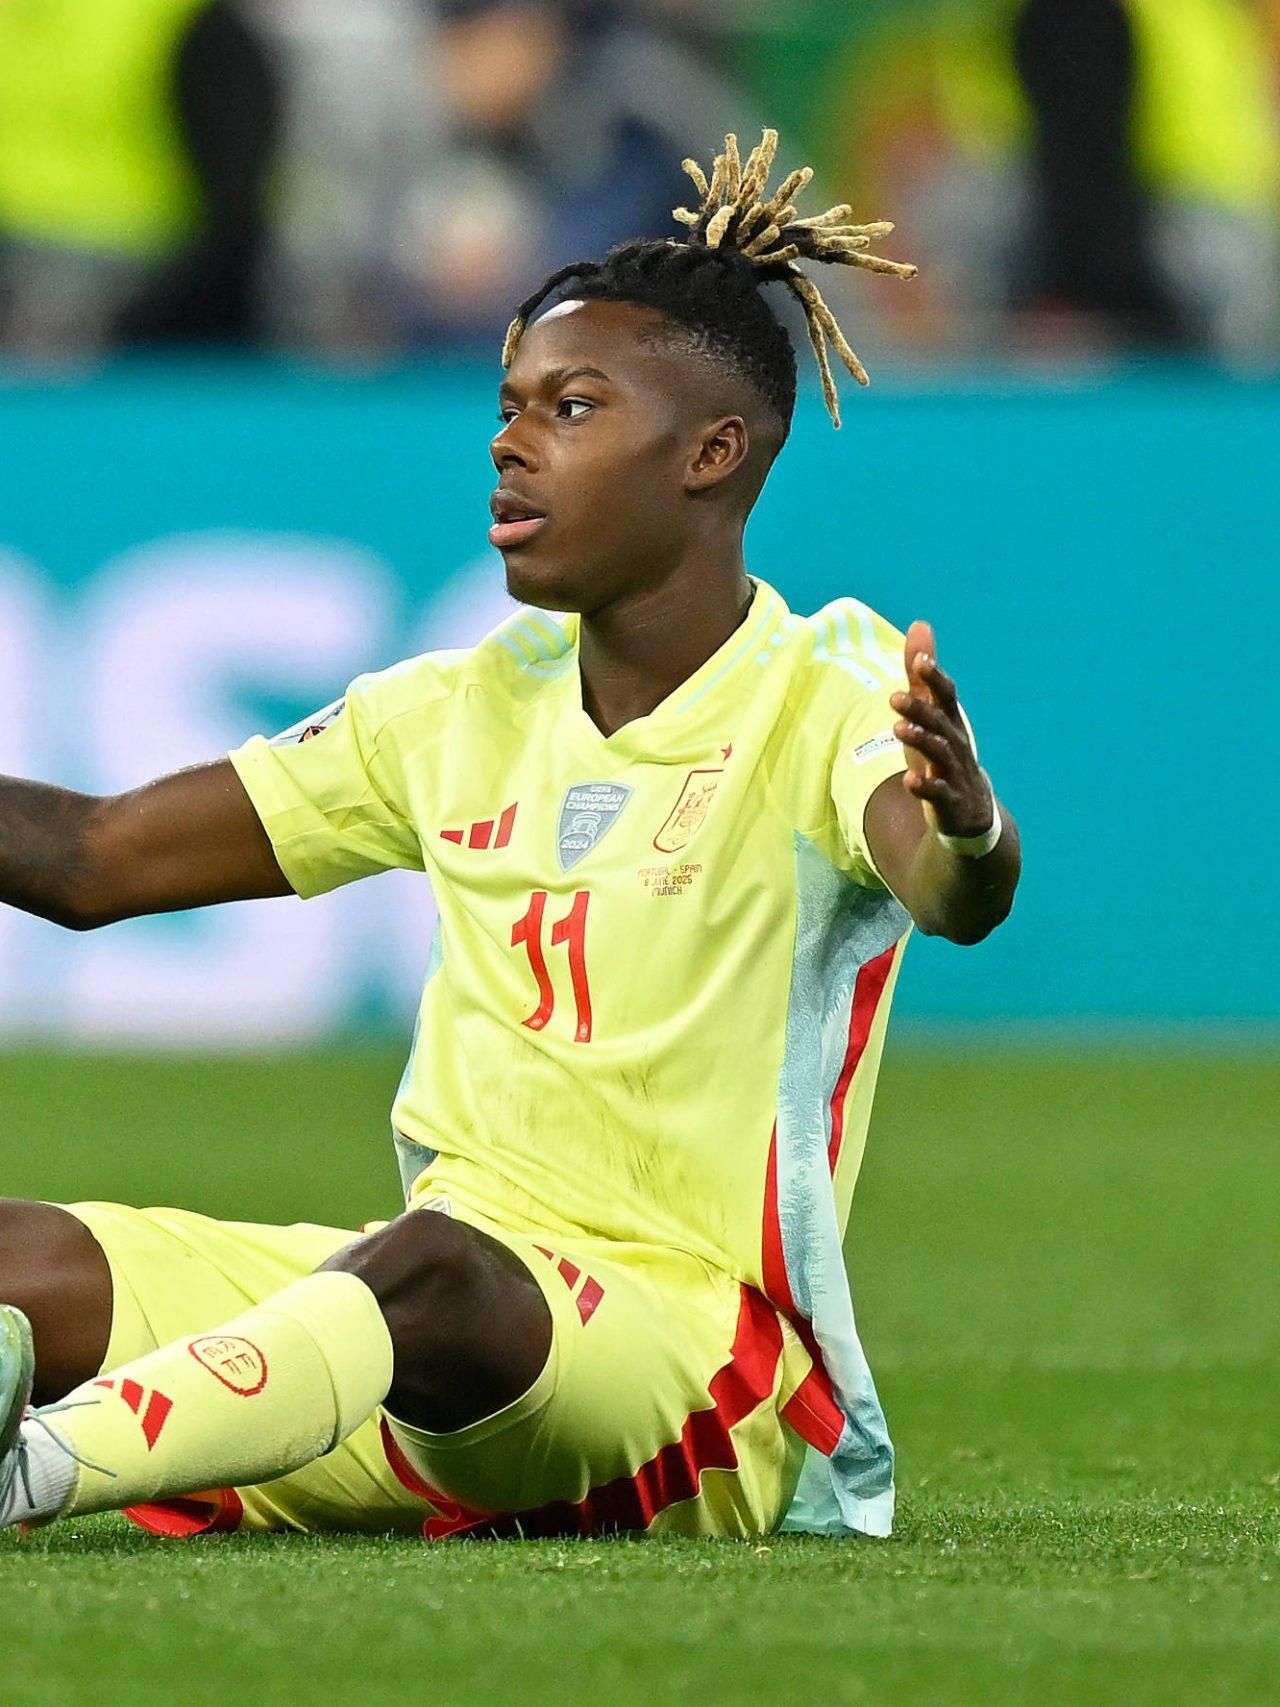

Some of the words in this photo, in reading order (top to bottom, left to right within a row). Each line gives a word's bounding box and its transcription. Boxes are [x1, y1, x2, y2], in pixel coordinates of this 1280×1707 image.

[569, 792, 625, 803] EUROPEAN
[565, 801, 621, 811] CHAMPIONS
[560, 838, 589, 849] 2024
[679, 864, 703, 874] SPAIN
[651, 886, 683, 897] MUNICH
[511, 890, 592, 1043] 11
